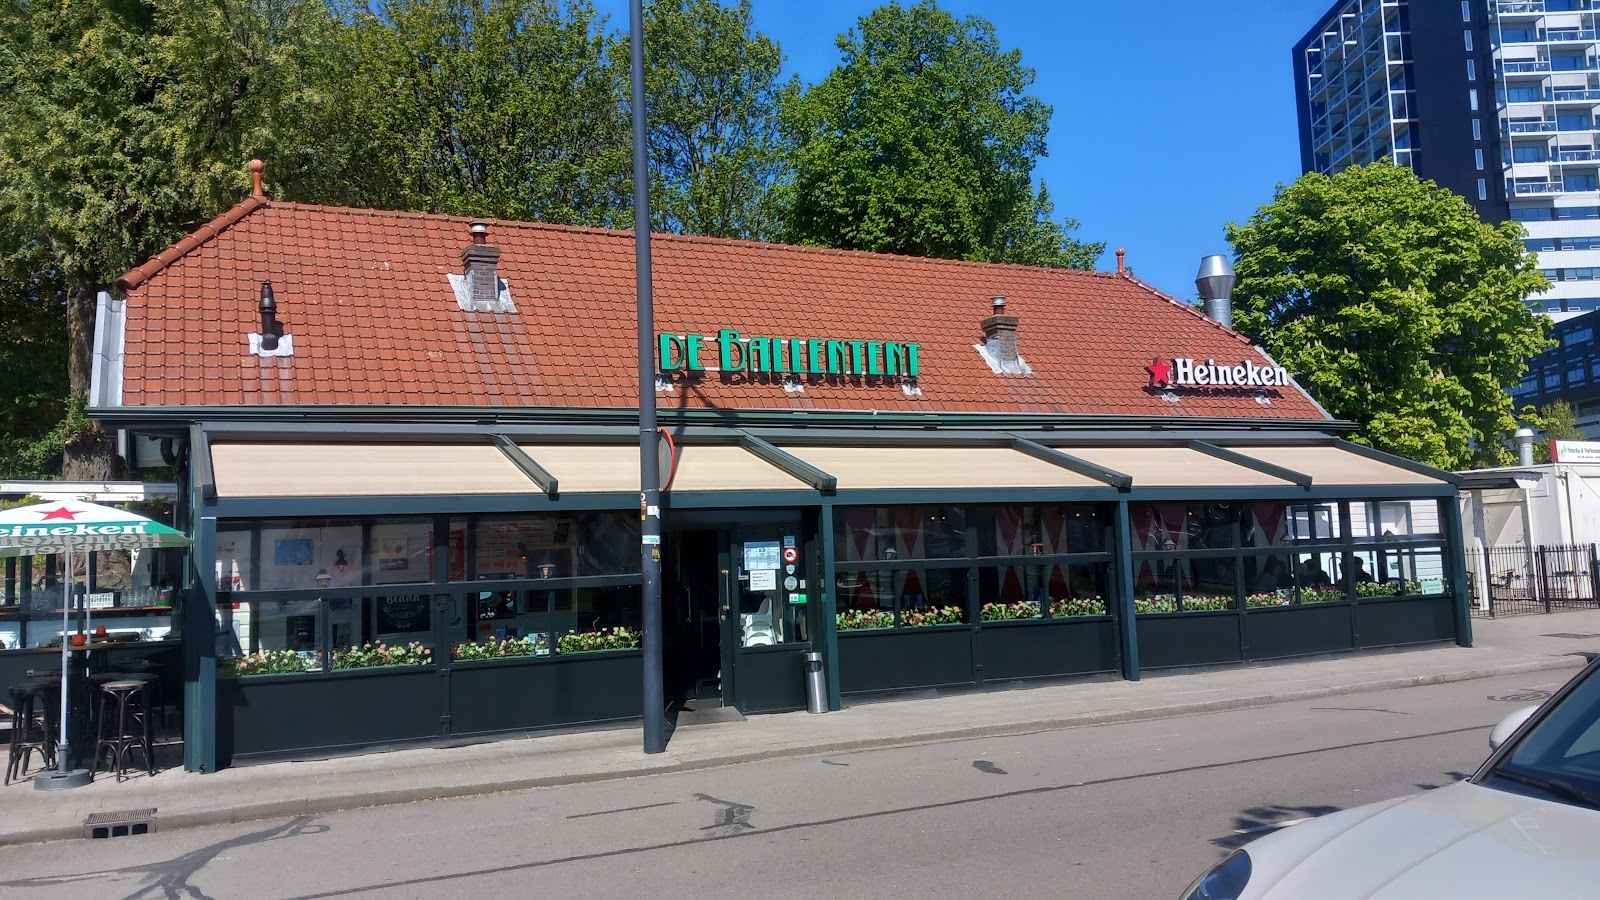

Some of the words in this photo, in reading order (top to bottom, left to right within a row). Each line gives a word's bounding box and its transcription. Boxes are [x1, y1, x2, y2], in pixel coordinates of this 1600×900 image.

[659, 333, 704, 371] DE
[718, 329, 921, 377] BALLENTENT
[1174, 358, 1289, 386] Heineken
